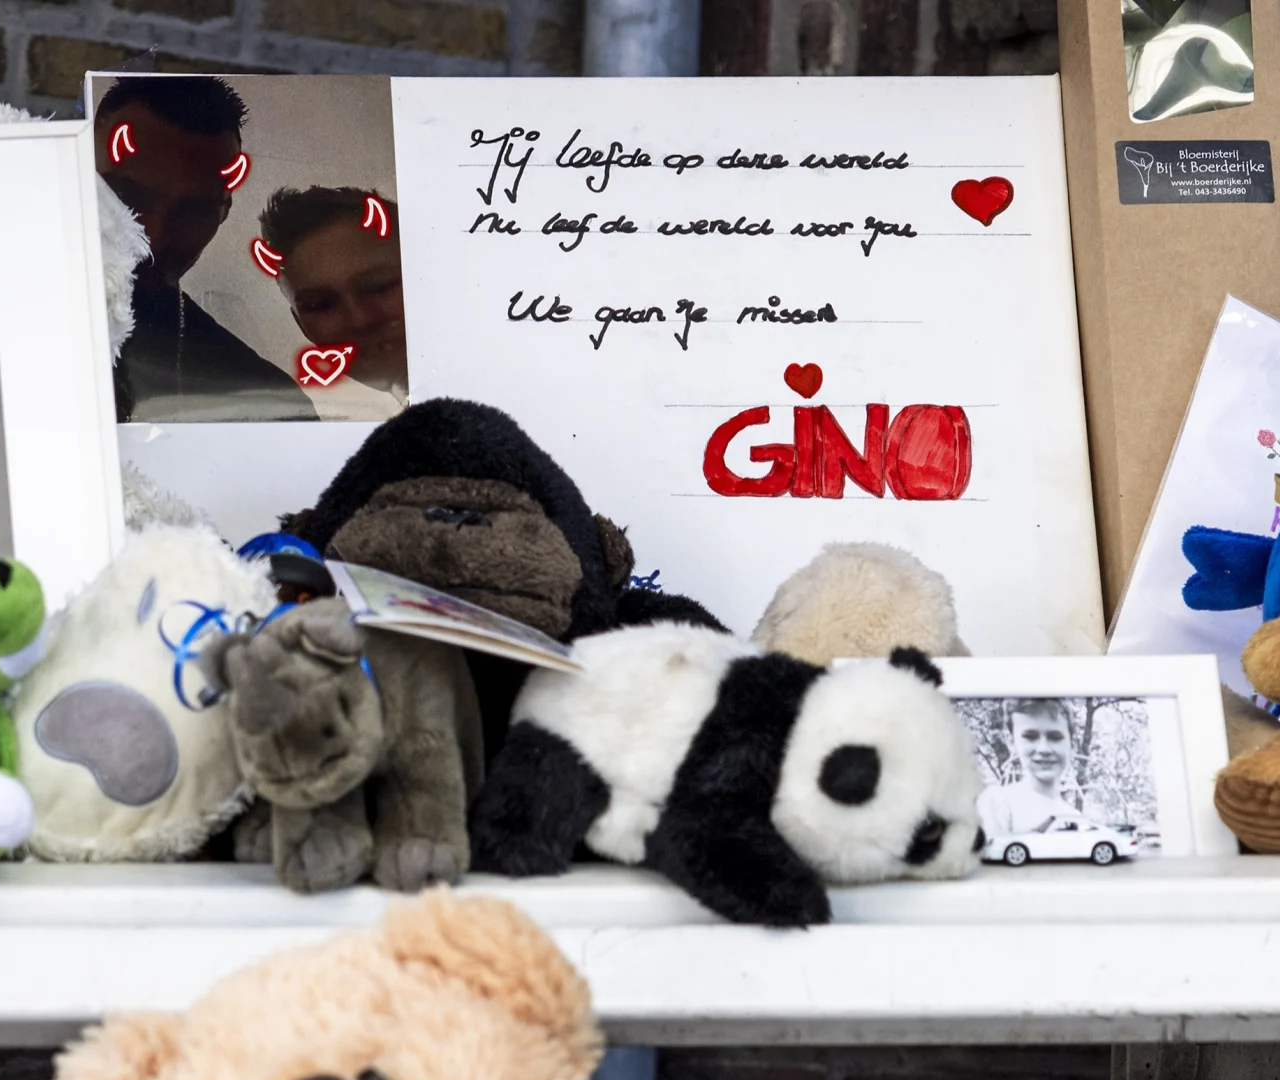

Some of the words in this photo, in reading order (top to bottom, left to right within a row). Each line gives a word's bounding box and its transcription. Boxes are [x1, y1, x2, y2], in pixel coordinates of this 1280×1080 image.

[1179, 149, 1239, 161] Bloemisterij
[471, 127, 540, 205] Jij
[663, 153, 705, 175] op
[717, 147, 790, 171] deze
[799, 148, 910, 172] wereld
[1156, 161, 1173, 177] Bij
[1190, 160, 1265, 176] Boerderijke
[1171, 177, 1252, 187] www.boerderijke.nl
[1178, 188, 1194, 197] Tel.
[1194, 187, 1247, 196] 043-3436490
[541, 212, 599, 252] leef
[599, 215, 639, 235] de
[656, 215, 775, 236] wereld
[790, 218, 855, 238] voor
[507, 291, 575, 324] We
[589, 304, 667, 351] gaan
[736, 294, 839, 325] missen
